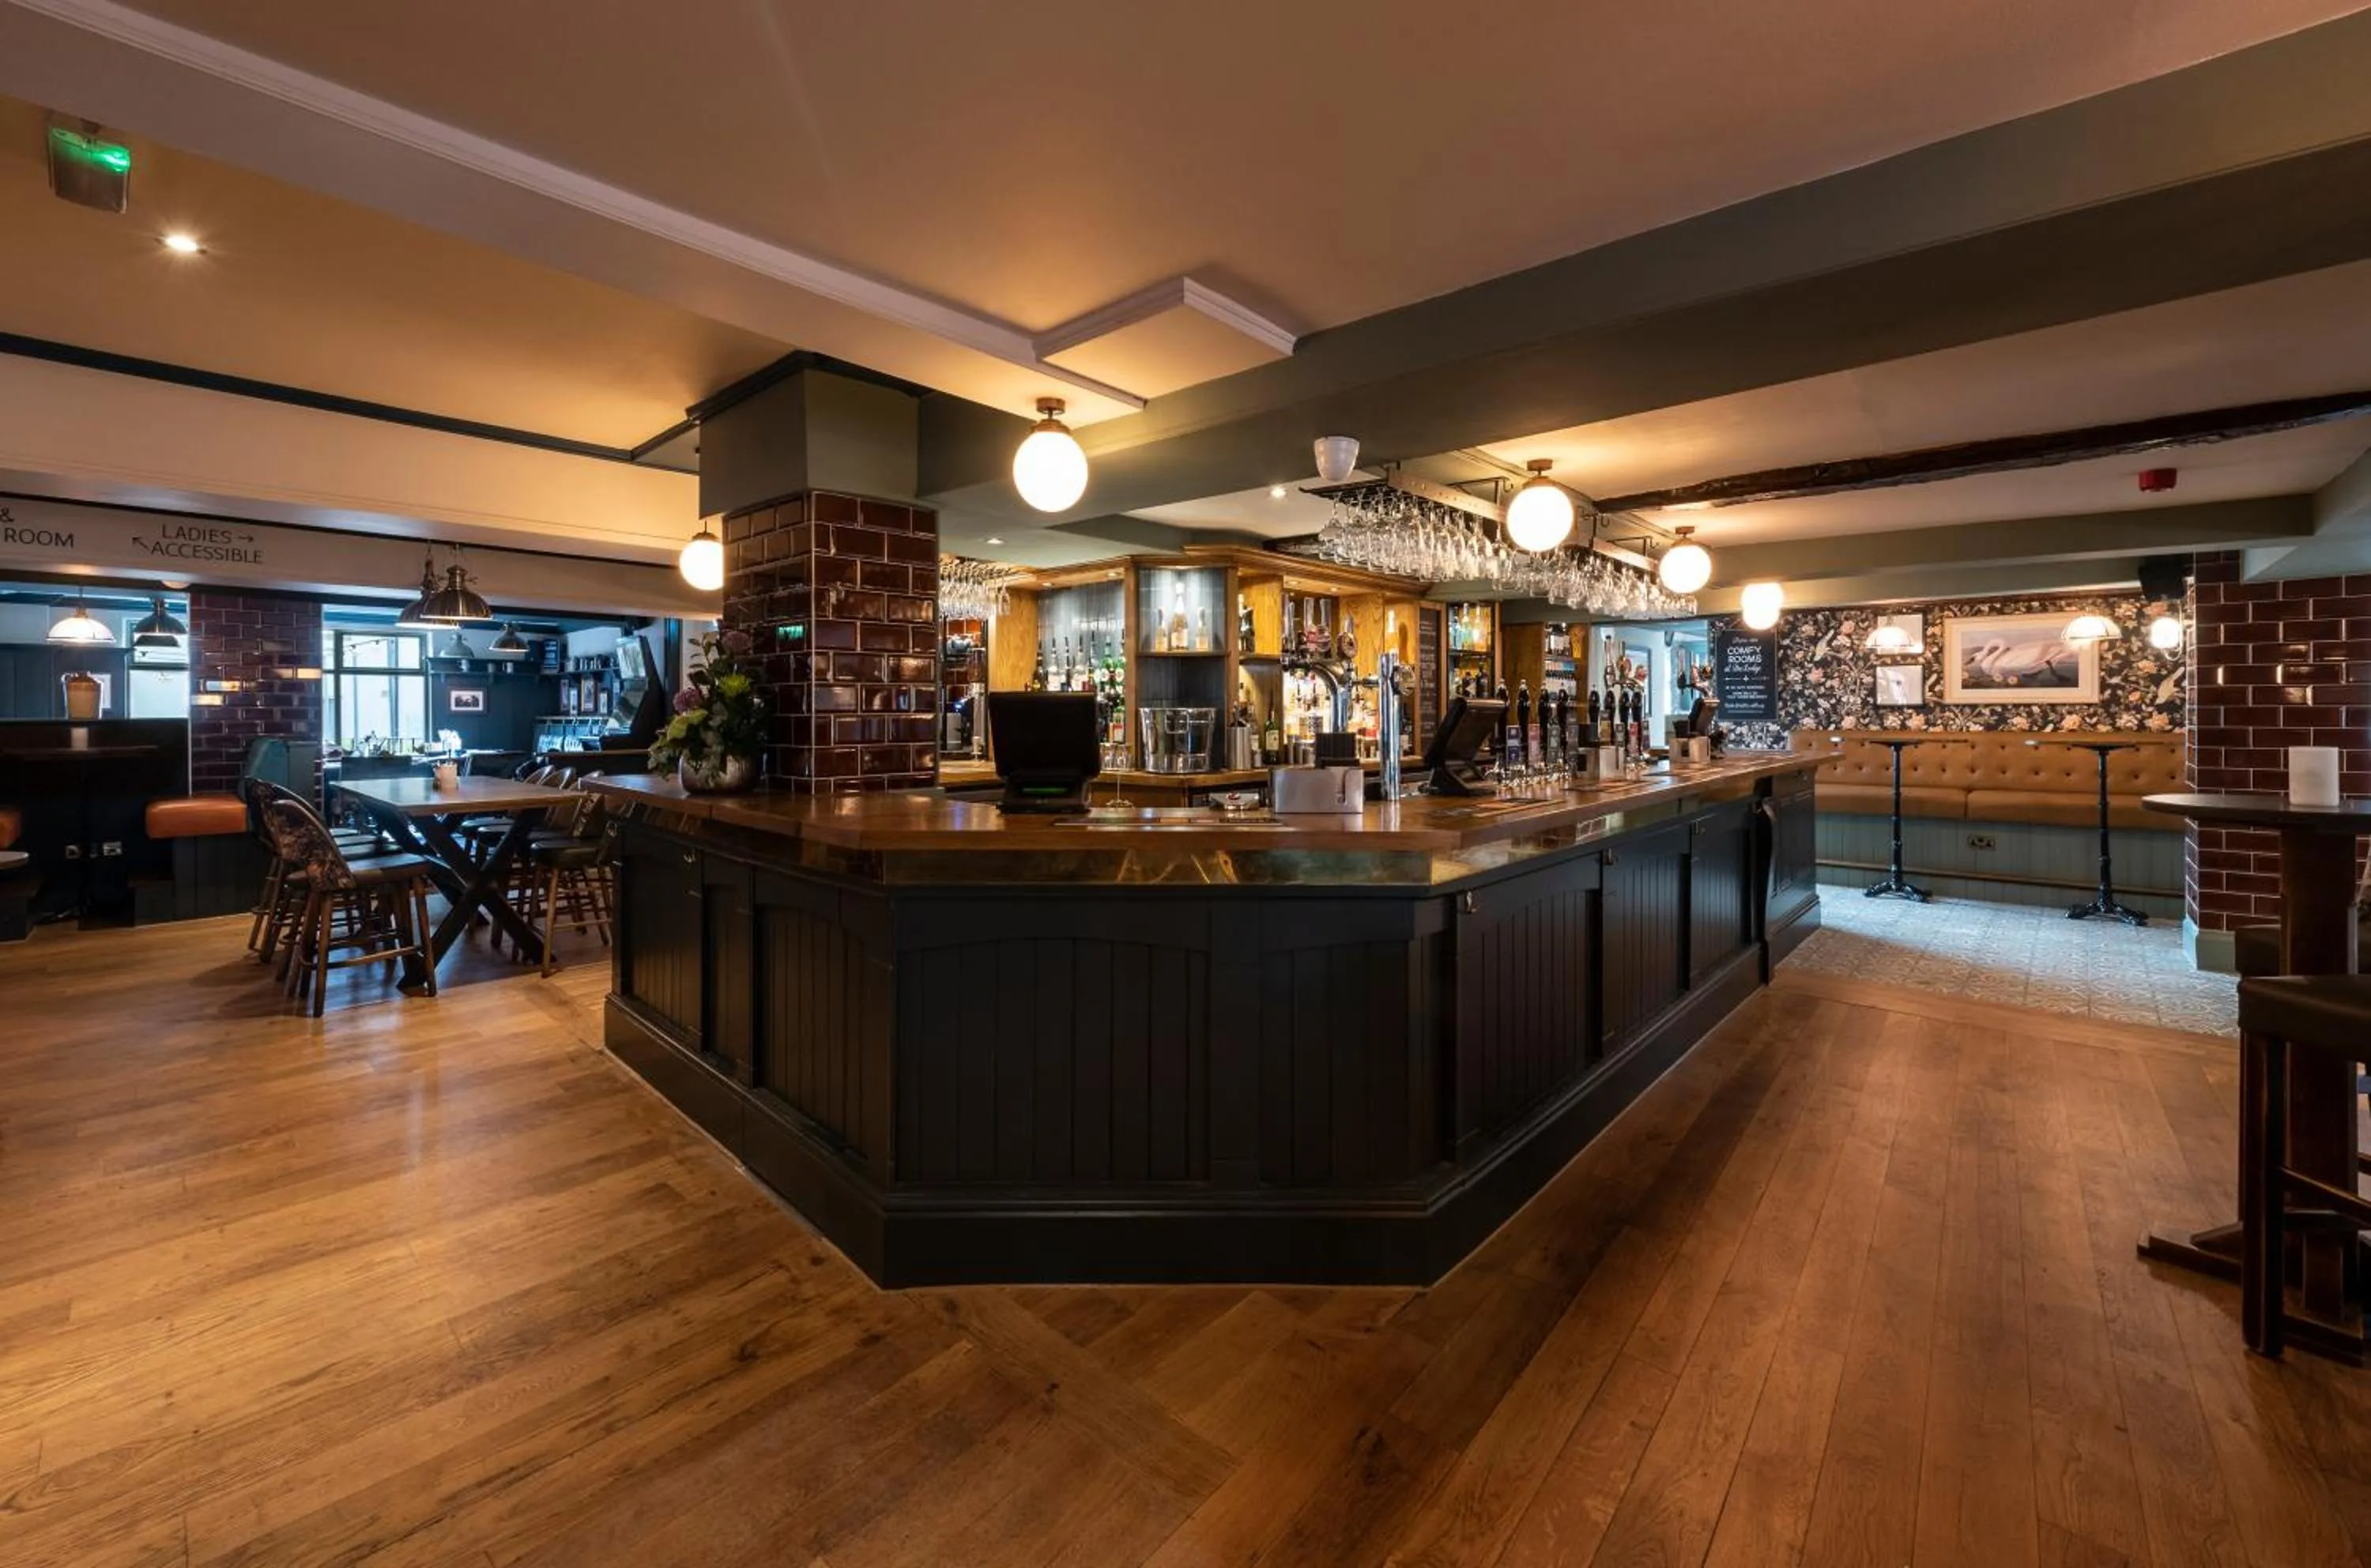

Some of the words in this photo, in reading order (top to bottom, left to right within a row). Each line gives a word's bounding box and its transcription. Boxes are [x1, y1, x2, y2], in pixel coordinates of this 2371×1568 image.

[0, 507, 14, 522] &
[4, 527, 74, 548] ROOM
[162, 524, 232, 545] LADIES
[151, 541, 265, 564] ACCESSIBLE
[1727, 645, 1762, 655] COMFY
[1728, 654, 1762, 663] ROOMS
